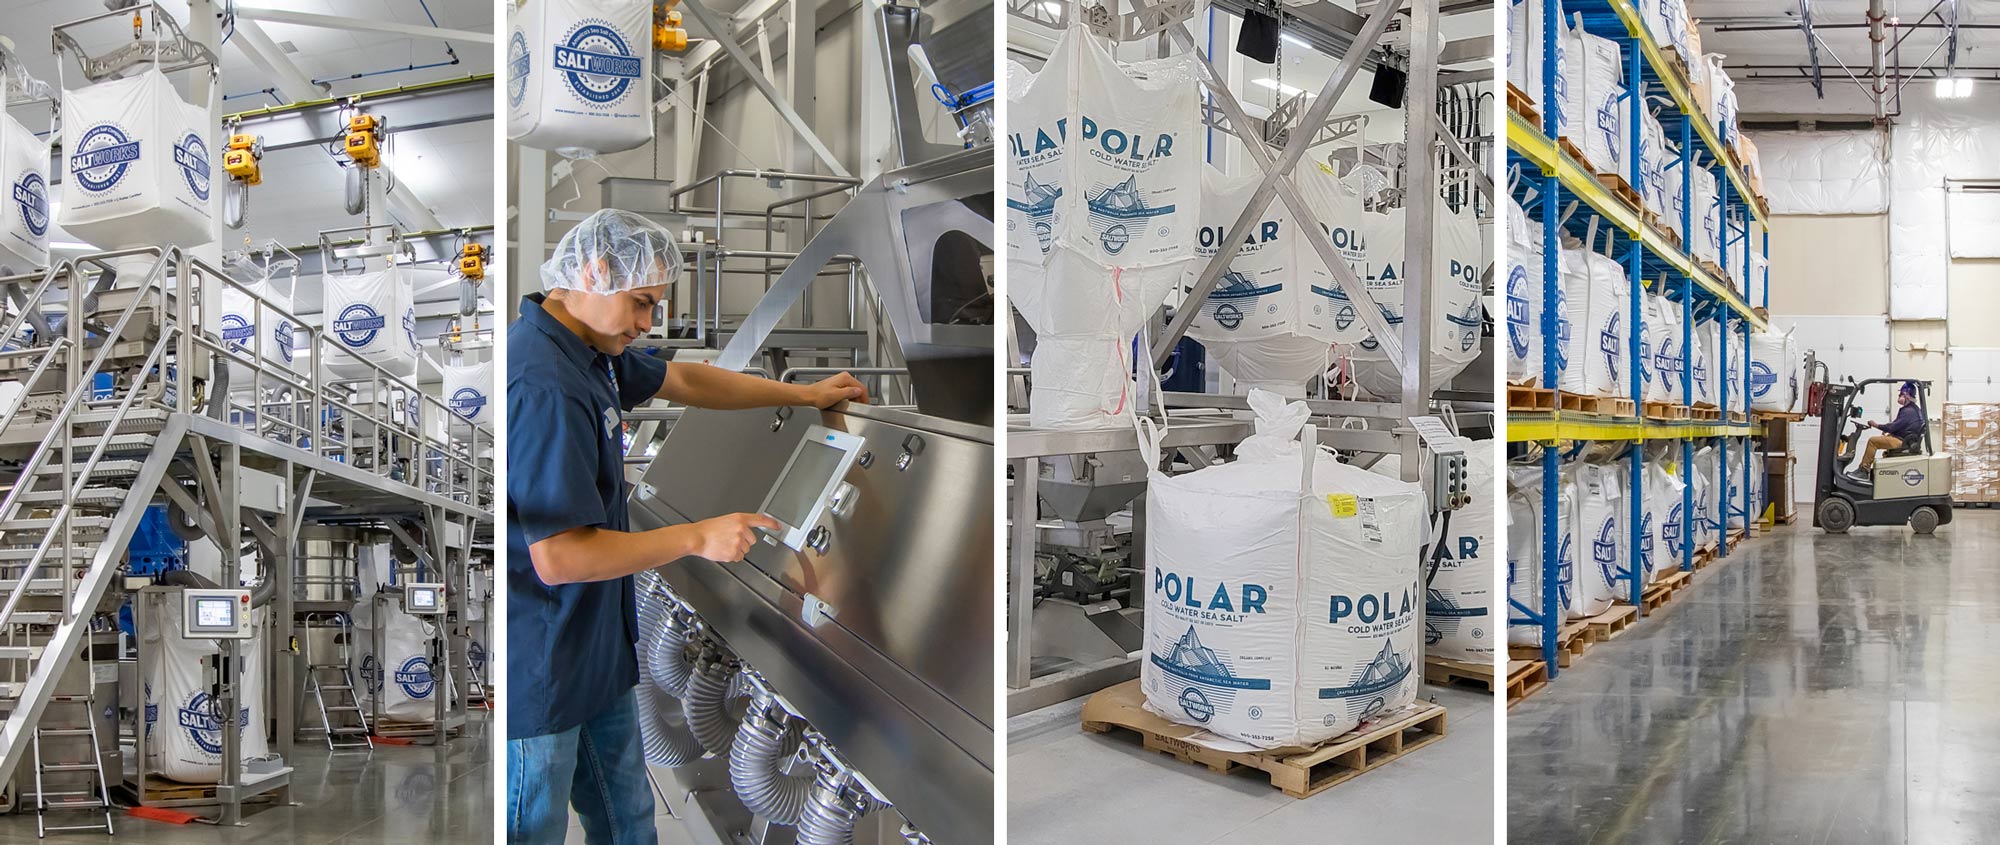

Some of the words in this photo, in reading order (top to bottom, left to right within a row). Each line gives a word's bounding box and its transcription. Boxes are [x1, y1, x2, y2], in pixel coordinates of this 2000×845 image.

[557, 50, 639, 76] SALTWORKS
[574, 81, 610, 100] ESTABLISHED
[1600, 113, 1616, 130] SALT
[1082, 116, 1173, 158] POLR
[72, 145, 138, 171] SALTWORKS
[1032, 152, 1045, 163] SEA
[1089, 149, 1112, 162] COLD
[1115, 157, 1141, 168] WATER
[15, 186, 36, 207] SALT
[1246, 244, 1263, 252] SALT
[1367, 261, 1404, 280] LA
[1602, 335, 1617, 352] SALT
[1656, 356, 1670, 370] SALT
[1664, 526, 1678, 539] SALT
[1596, 545, 1611, 560] SALT
[1155, 567, 1268, 614] POLAR
[1161, 599, 1173, 611] COLD
[1174, 605, 1198, 618] WATER
[1201, 612, 1217, 621] SEA
[1220, 614, 1244, 623] SALT
[1348, 625, 1370, 634] COLD
[1372, 621, 1394, 633] WATER
[1395, 618, 1404, 627] SEA
[396, 673, 417, 683] SALT
[1180, 698, 1214, 714] SALTWORKS
[1154, 733, 1201, 753] SALTWORKS
